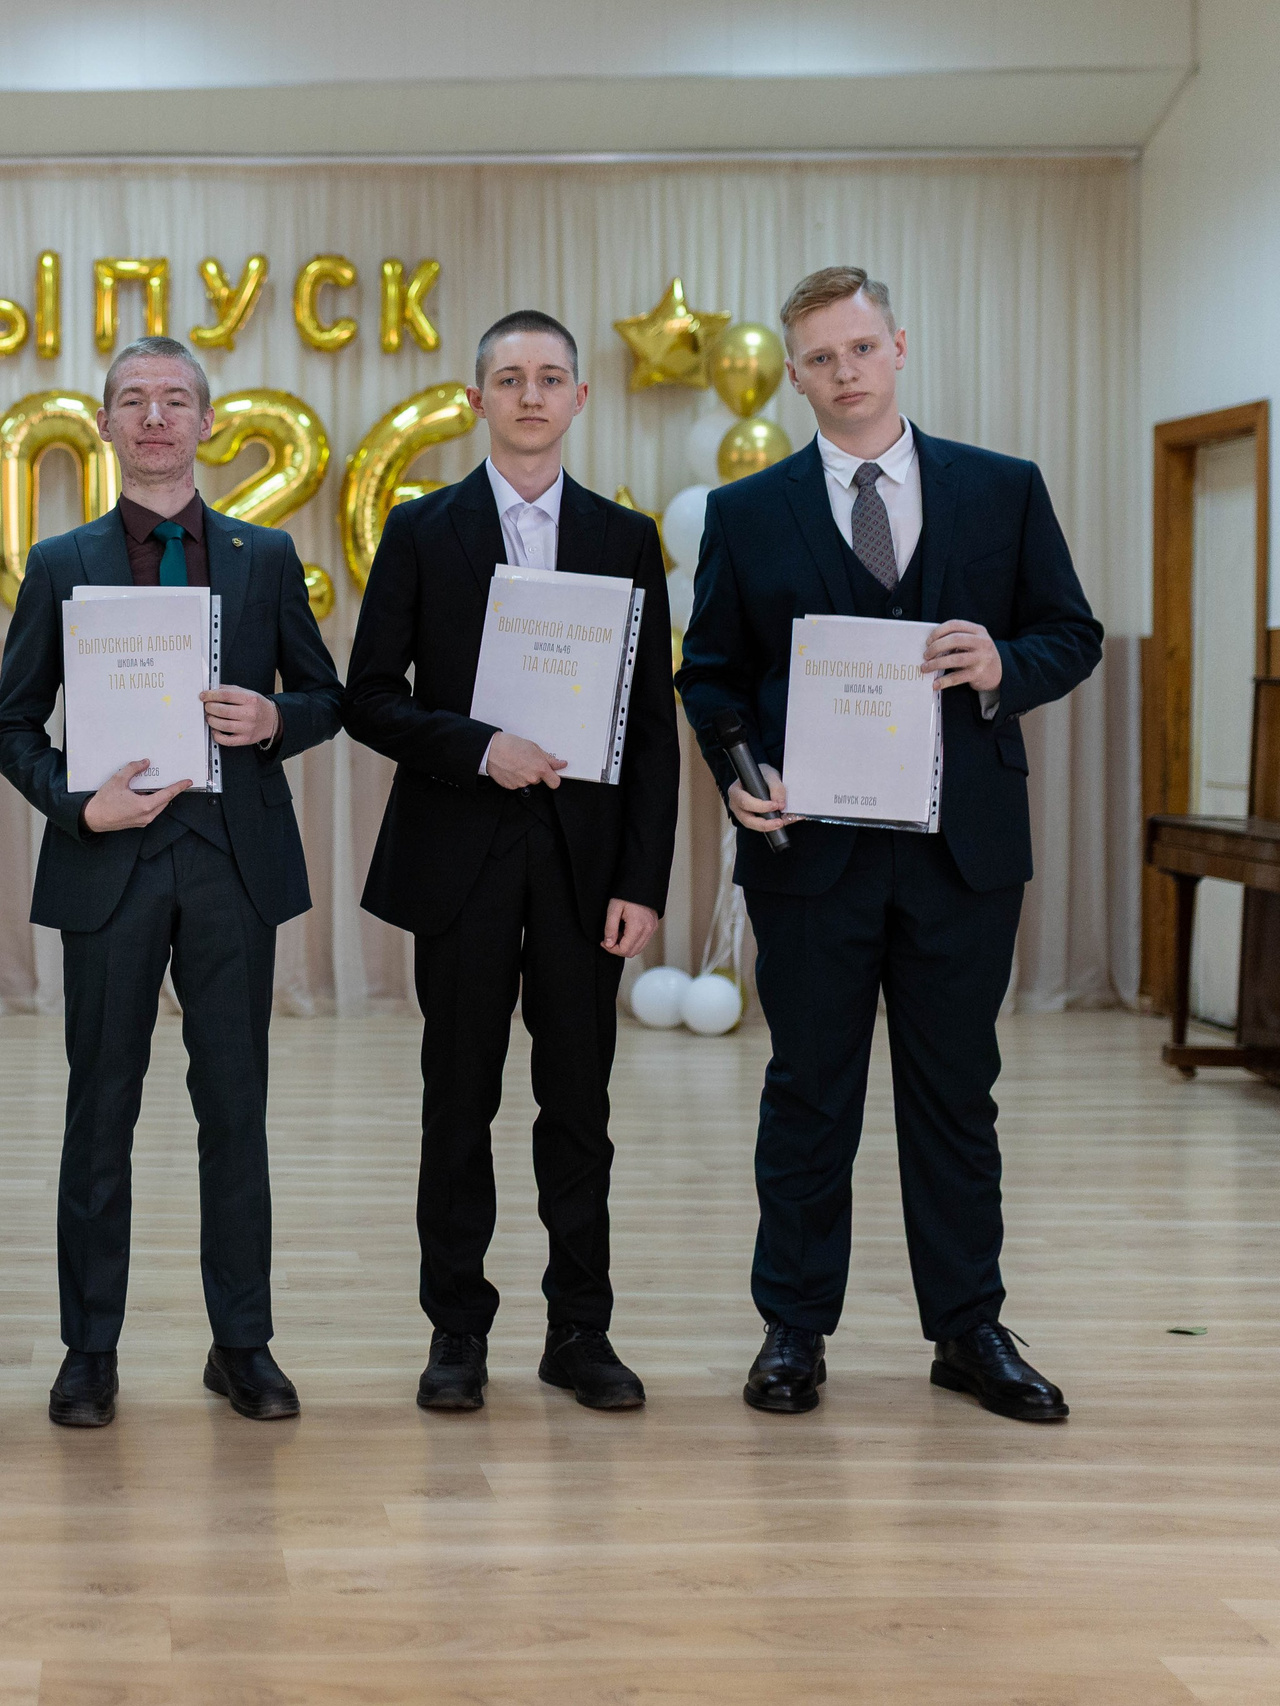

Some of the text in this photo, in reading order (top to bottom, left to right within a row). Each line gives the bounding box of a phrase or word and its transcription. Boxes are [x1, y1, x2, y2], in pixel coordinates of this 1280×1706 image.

[498, 616, 613, 644] ВЫПУСКНОЙ АЛЬБОМ
[78, 634, 192, 654] ВЫПУСКНОЙ АЛЬБОМ
[533, 642, 555, 652] ШКОЛА
[117, 658, 138, 668] ШКОЛА
[522, 655, 578, 677] 11А КЛАСС
[805, 659, 924, 681] ВЫПУСКНОЙ АЛЬБОМ
[108, 672, 165, 690] 11А КЛАСС
[843, 683, 866, 694] ШКОЛА
[833, 698, 892, 718] 11А КЛАСС
[833, 794, 877, 807] ВЫПУСК 2026
